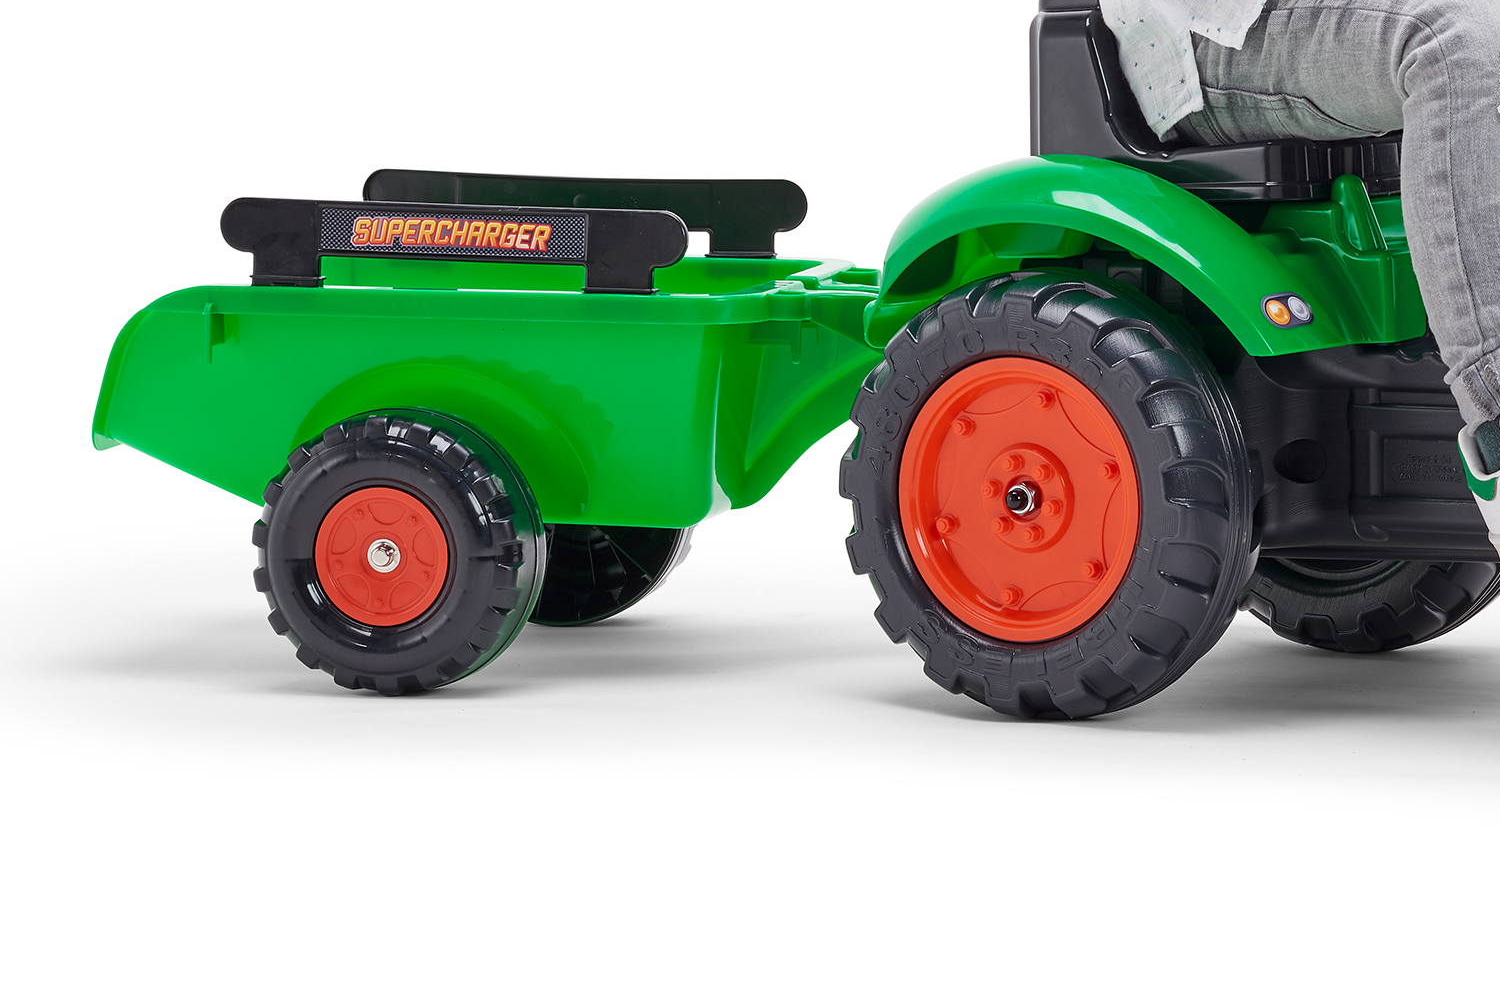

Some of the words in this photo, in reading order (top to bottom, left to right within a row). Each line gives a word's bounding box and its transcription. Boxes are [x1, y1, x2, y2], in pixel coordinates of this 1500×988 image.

[351, 217, 552, 251] SUPERCHARGER
[868, 330, 986, 480] 480/70
[1014, 329, 1104, 391] R30
[916, 538, 1157, 677] TUBELESS
